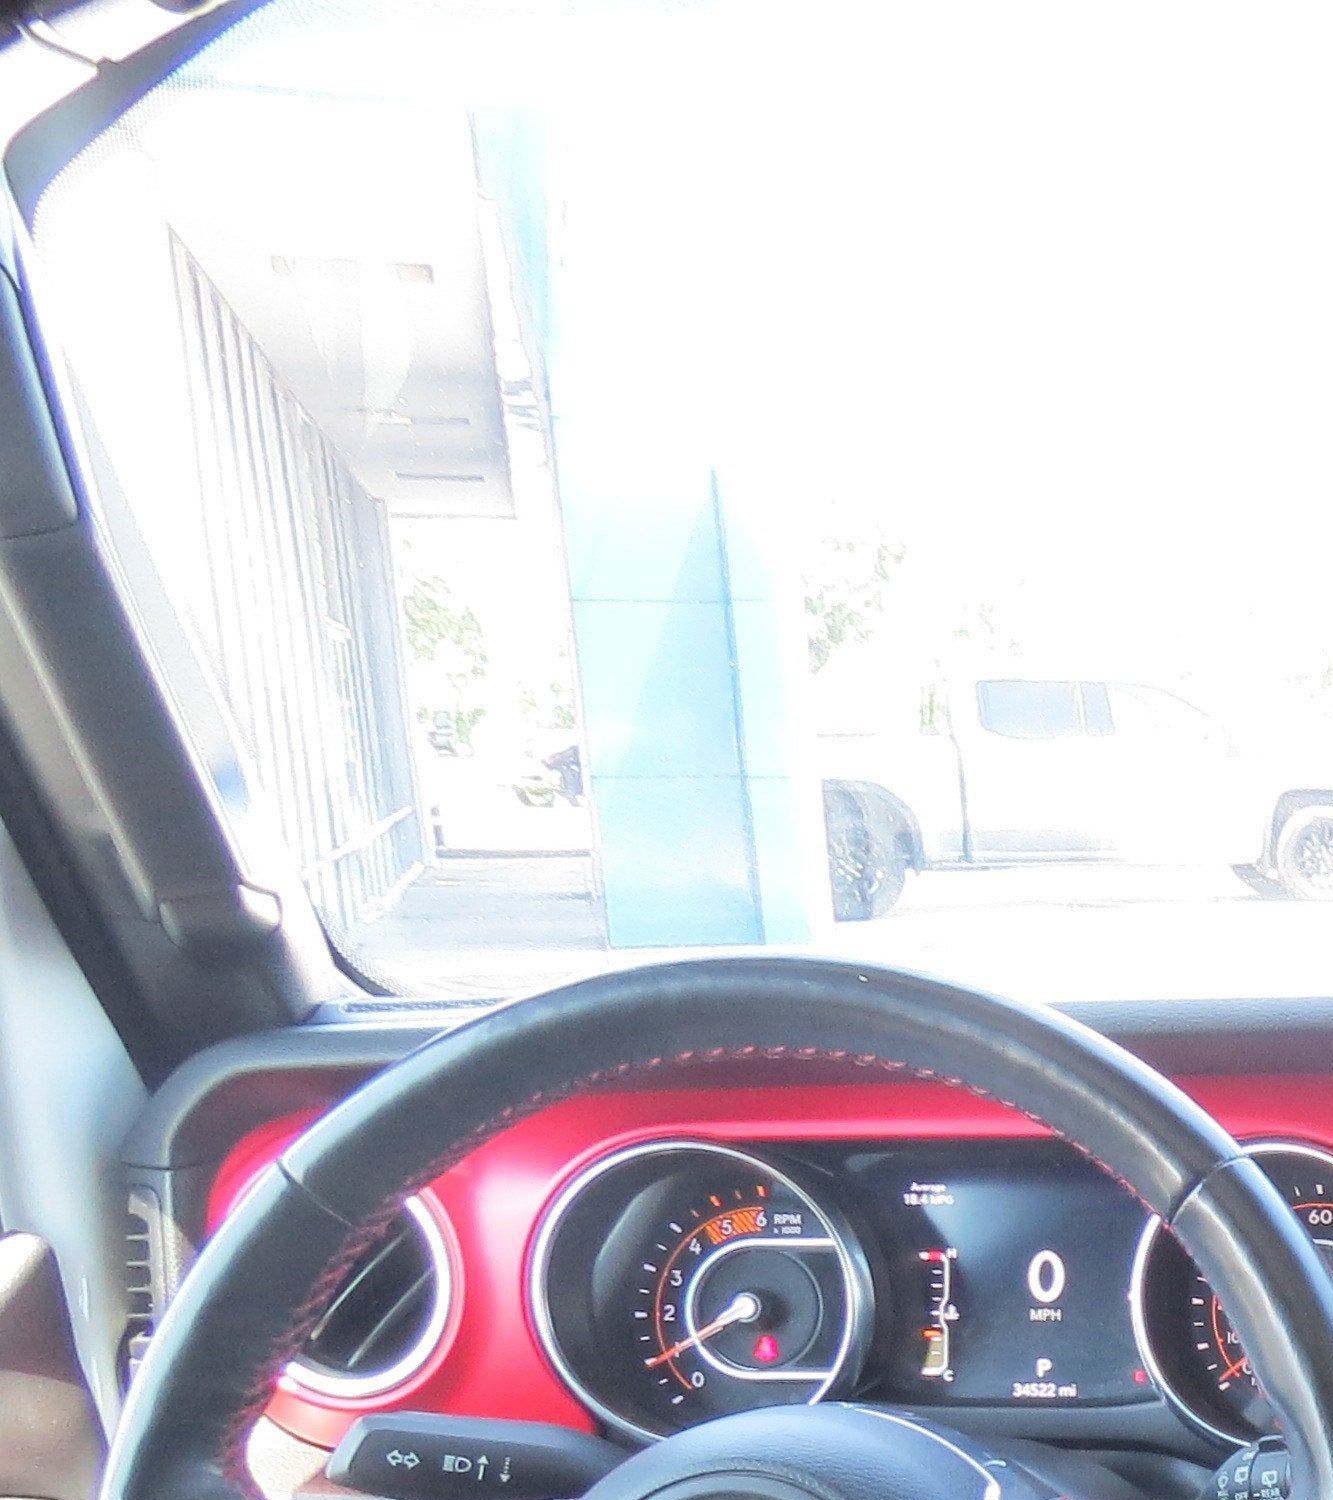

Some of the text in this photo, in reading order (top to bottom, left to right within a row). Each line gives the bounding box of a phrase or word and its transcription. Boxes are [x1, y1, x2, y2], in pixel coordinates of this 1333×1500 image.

[757, 1213, 767, 1227] 6
[774, 1214, 802, 1225] RPM
[1309, 1210, 1332, 1225] 60
[721, 1220, 733, 1235] 5
[689, 1238, 702, 1255] 4
[670, 1270, 682, 1286] 3
[1028, 1249, 1065, 1303] 0
[664, 1305, 675, 1321] 2
[1029, 1308, 1062, 1321] MPH
[1036, 1358, 1053, 1378] P
[692, 1372, 705, 1388] 0
[1012, 1382, 1077, 1398] 34522 mi
